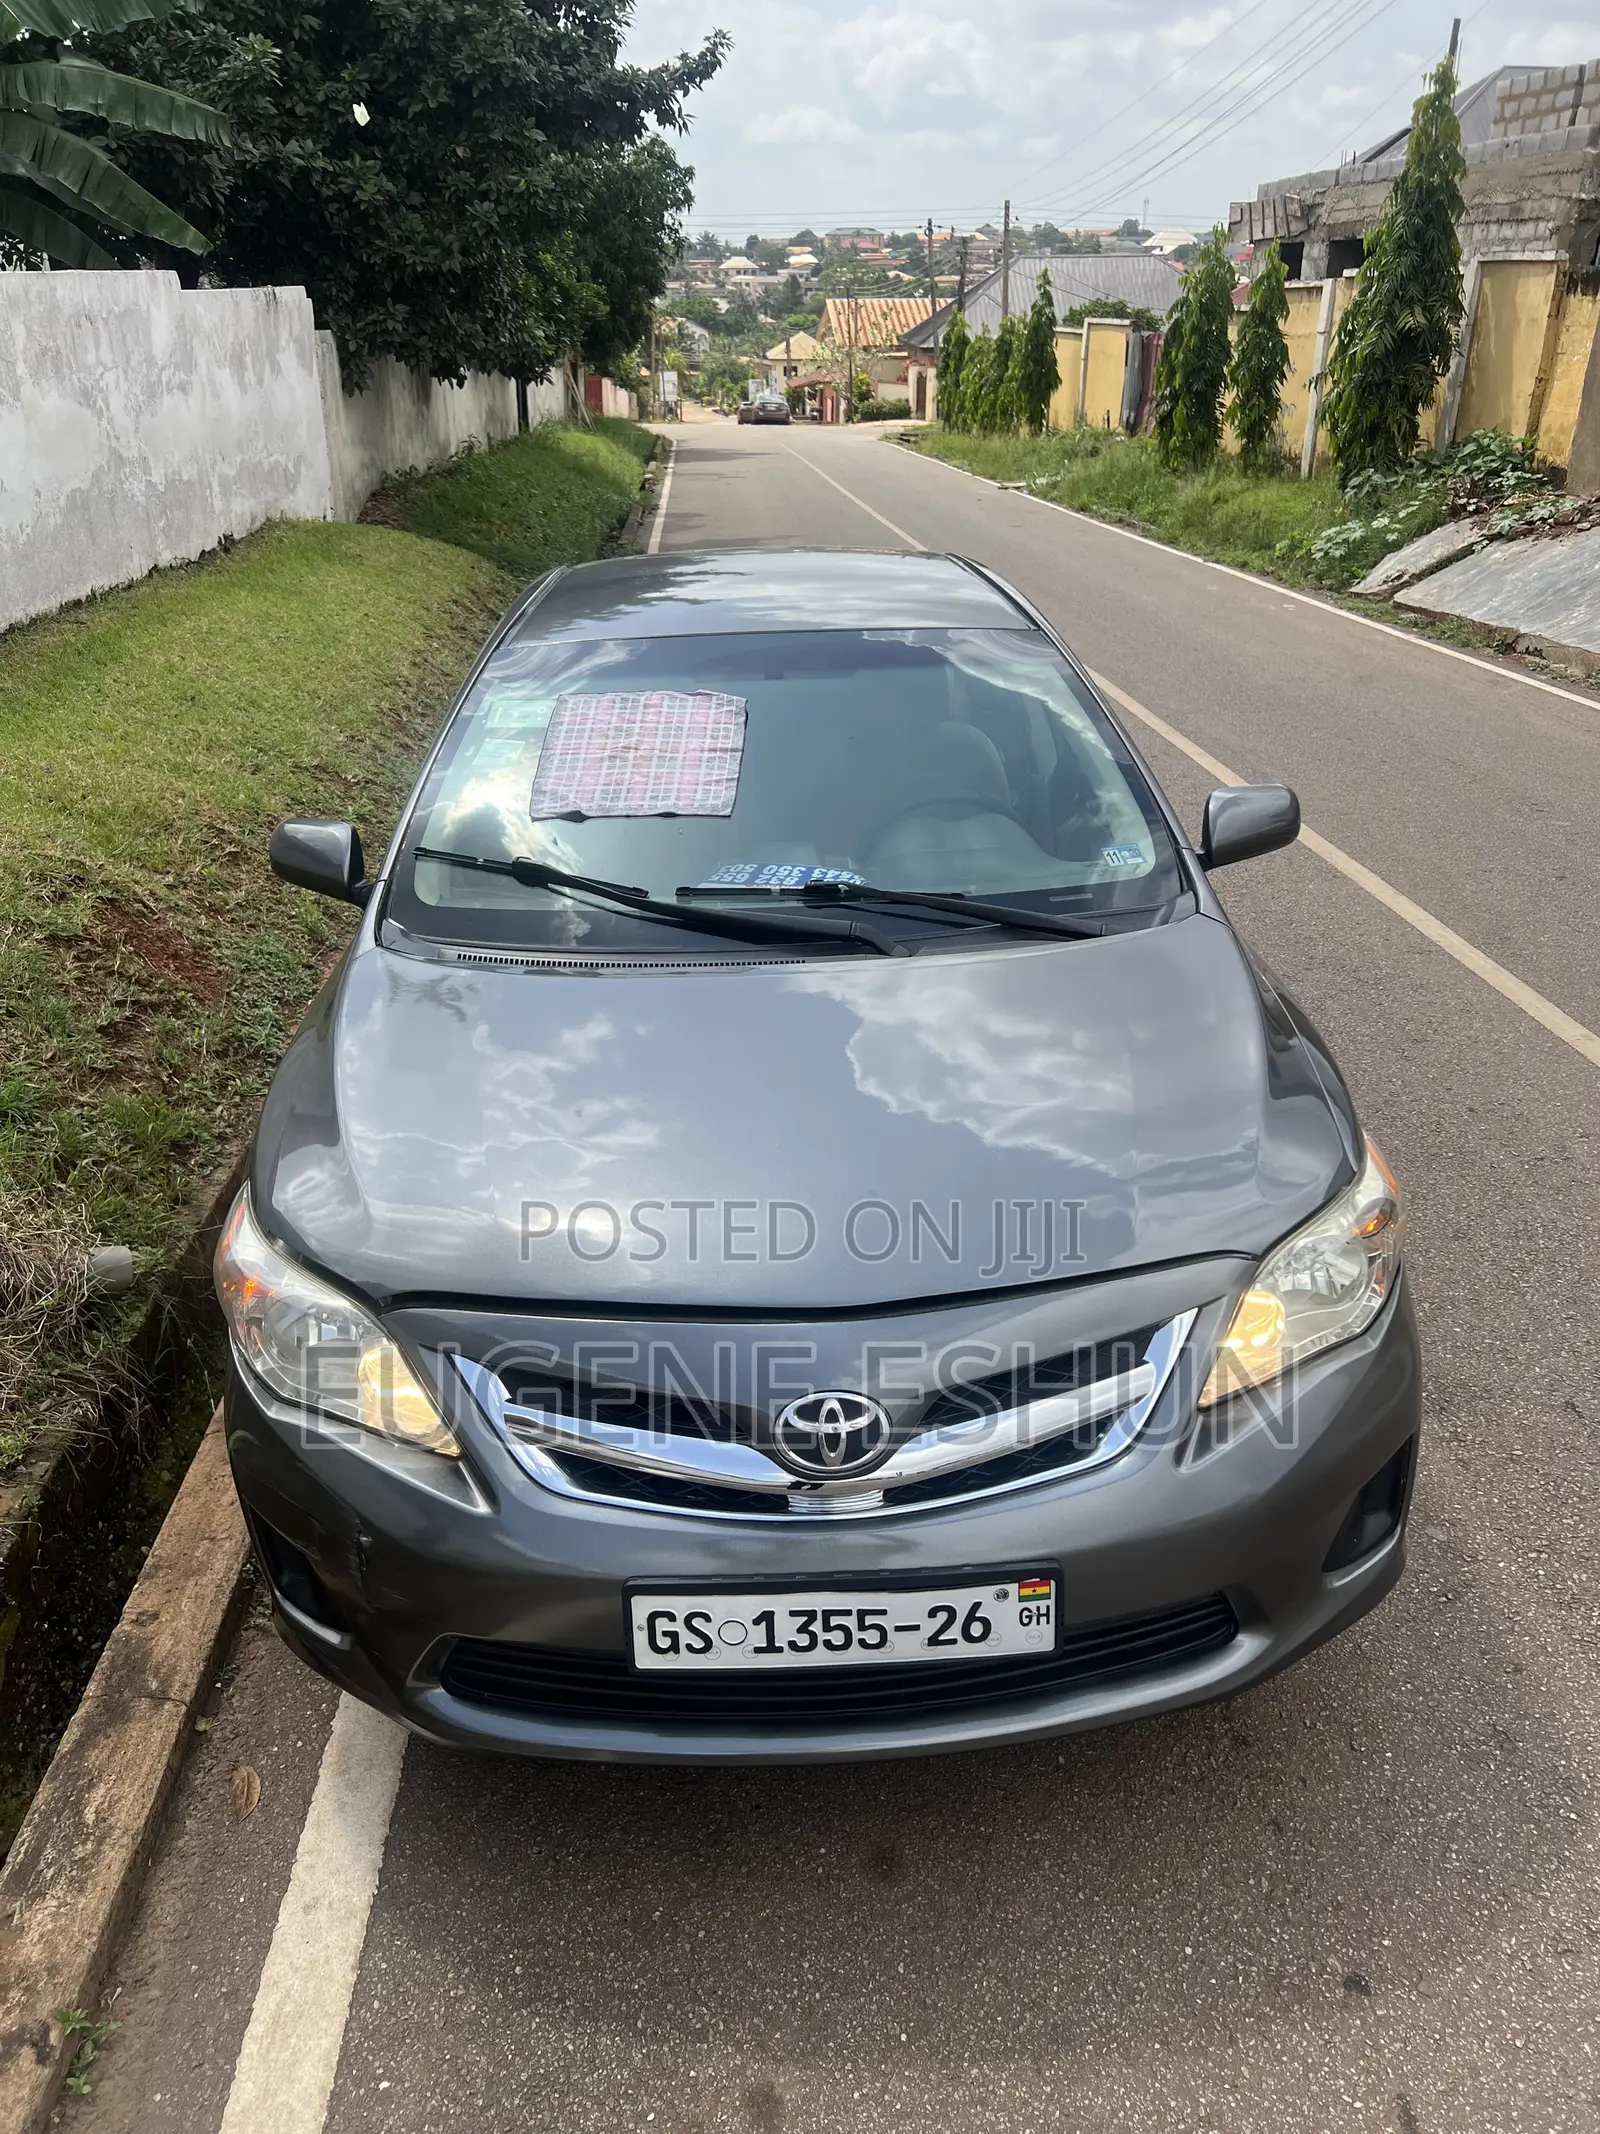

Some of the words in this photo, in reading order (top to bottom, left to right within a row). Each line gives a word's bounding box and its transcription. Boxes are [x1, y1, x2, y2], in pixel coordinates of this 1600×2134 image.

[754, 874, 800, 885] 832
[762, 864, 807, 877] 350
[1018, 1604, 1050, 1627] GH
[646, 1610, 714, 1655] GS
[752, 1600, 992, 1654] 1355-26
